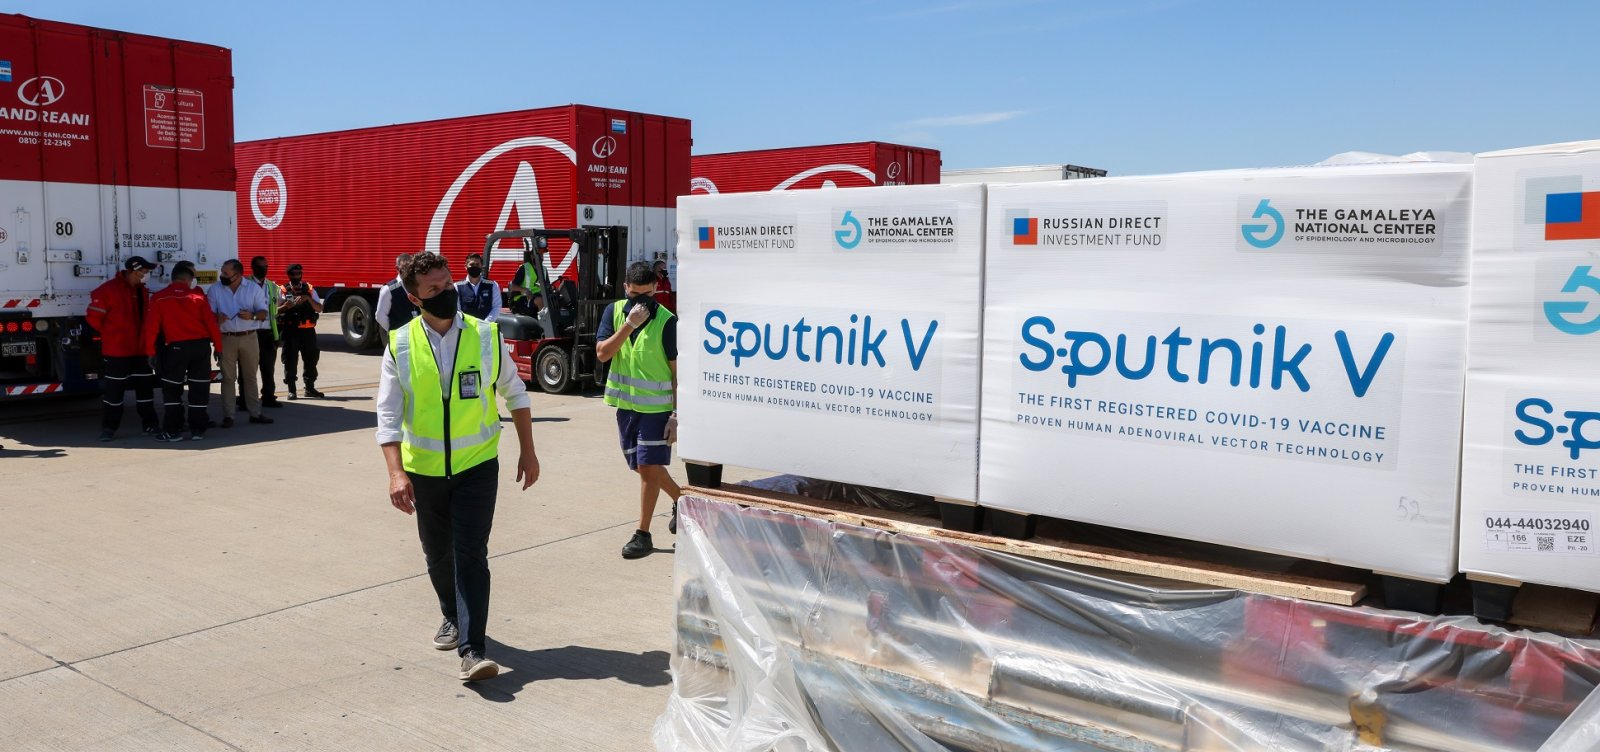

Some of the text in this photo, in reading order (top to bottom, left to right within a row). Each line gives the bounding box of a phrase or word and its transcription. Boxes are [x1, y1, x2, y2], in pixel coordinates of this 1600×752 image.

[0, 129, 89, 141] WWW.ANDEANI.COM.AR
[584, 207, 593, 219] 80
[1296, 209, 1436, 221] THE GAMALEYA
[867, 216, 953, 226] THE GAMALEYA
[1043, 217, 1161, 229] RUSSIAN DIRECT
[55, 221, 73, 236] 80
[717, 225, 793, 236] RUSSIAN DIRECT
[867, 227, 954, 236] NATIONAL CENTER
[1295, 223, 1436, 235] NATIONAL CENTER
[718, 239, 795, 249] INVESTMENT FUND
[1043, 234, 1162, 246] INVESTMENT FUND
[900, 318, 939, 371] V
[1334, 329, 1395, 398] V
[703, 372, 933, 404] THE FIRST REGISTERED COVID-19 VACCINE
[702, 389, 933, 422] PROVEN HUMAN ADENOVIRAL VECTOR TECHNOLOGY
[1018, 392, 1386, 440] THE FIRST REGISTERED COVID-19 VACCINE
[1017, 414, 1385, 463] PROVEN HUMAN ADENOVIRAL VECTOR TECHNOLOGY
[1514, 463, 1598, 479] THE FIRST
[1513, 482, 1564, 494] PROVEN
[1485, 517, 1590, 531] 044-44032940
[1567, 535, 1586, 543] EZE
